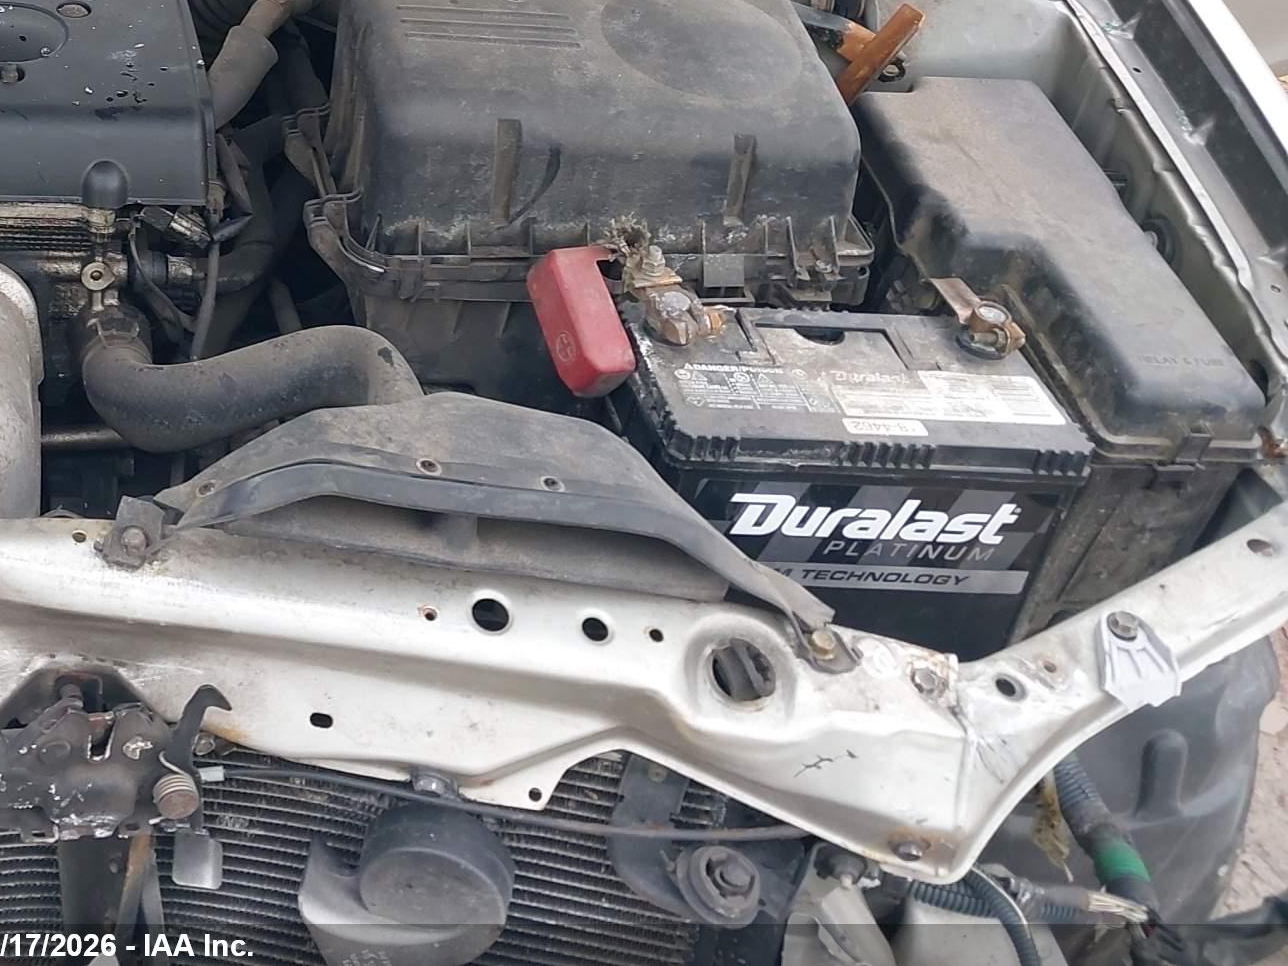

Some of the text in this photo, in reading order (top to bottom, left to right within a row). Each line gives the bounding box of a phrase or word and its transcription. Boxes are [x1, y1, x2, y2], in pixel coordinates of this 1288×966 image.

[729, 492, 1018, 545] Duralast
[822, 540, 996, 562] PLATINUM
[801, 569, 970, 585] TECHNOLOGY
